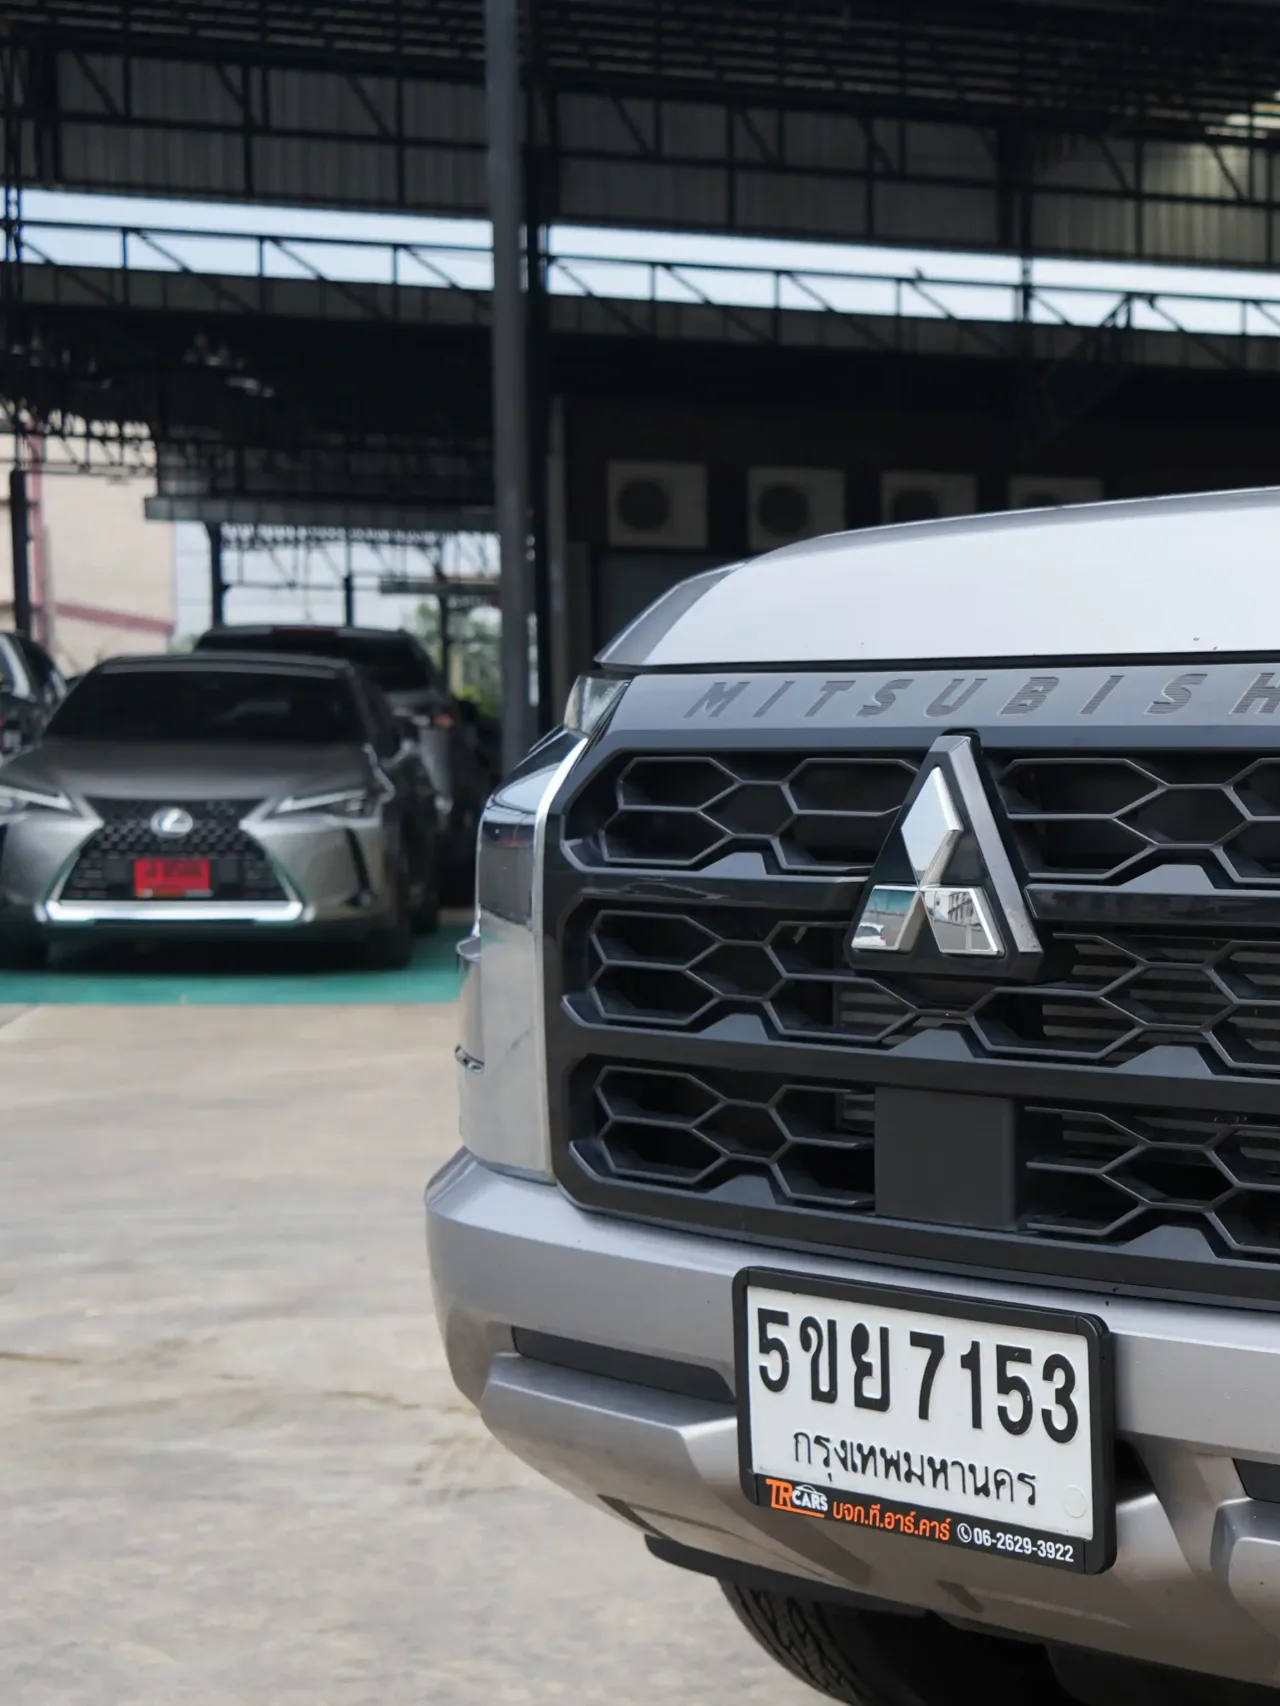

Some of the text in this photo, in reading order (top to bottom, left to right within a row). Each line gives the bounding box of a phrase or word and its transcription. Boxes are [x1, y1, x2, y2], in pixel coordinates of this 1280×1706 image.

[757, 1307, 1079, 1445] 5ขย 7153
[793, 1431, 1038, 1506] กรุงเทพมหานคร
[973, 1527, 1075, 1562] 06-2629-3922
